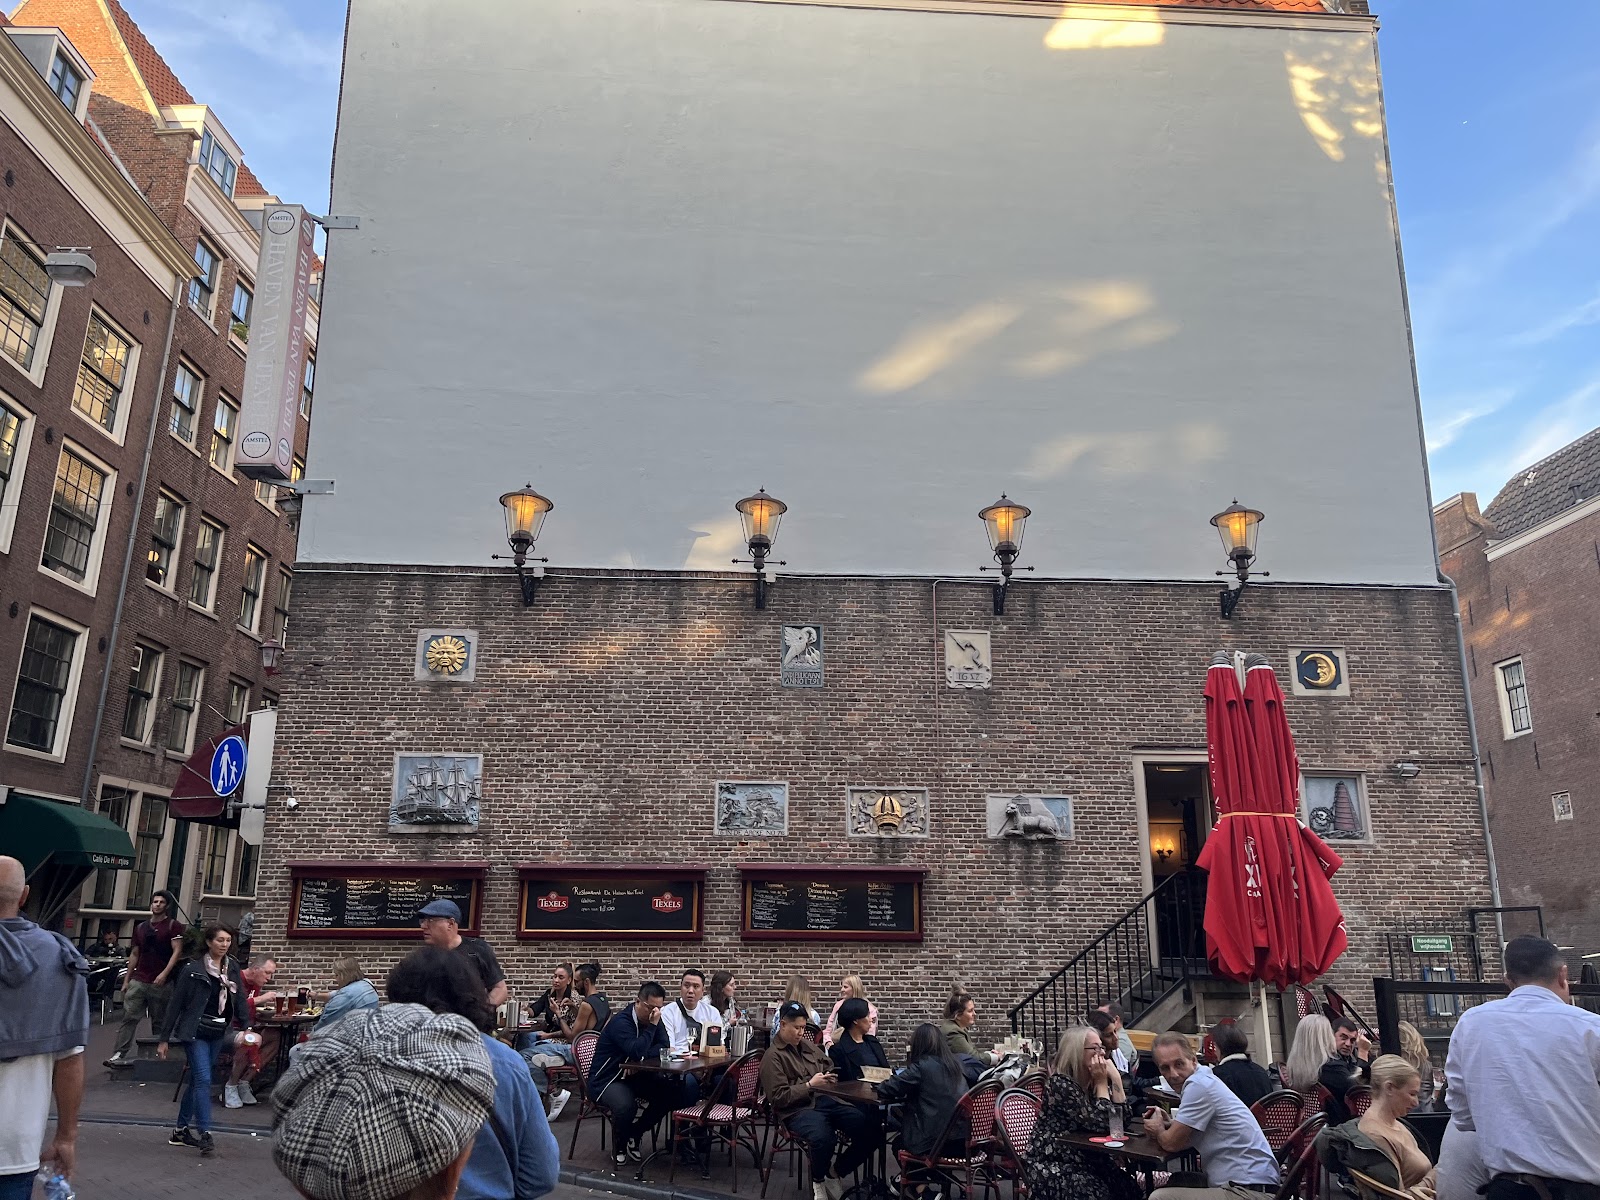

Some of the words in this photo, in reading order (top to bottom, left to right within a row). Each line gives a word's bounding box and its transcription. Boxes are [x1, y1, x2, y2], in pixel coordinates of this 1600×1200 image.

[264, 242, 286, 307] HAVEN
[295, 248, 308, 318] HAVEN
[259, 314, 279, 353] VAN
[290, 325, 301, 364] VAN
[282, 368, 297, 432] TEXEL
[92, 854, 103, 863] Café
[103, 855, 110, 864] De
[539, 898, 567, 908] TEXELS
[653, 898, 681, 908] TEXELS
